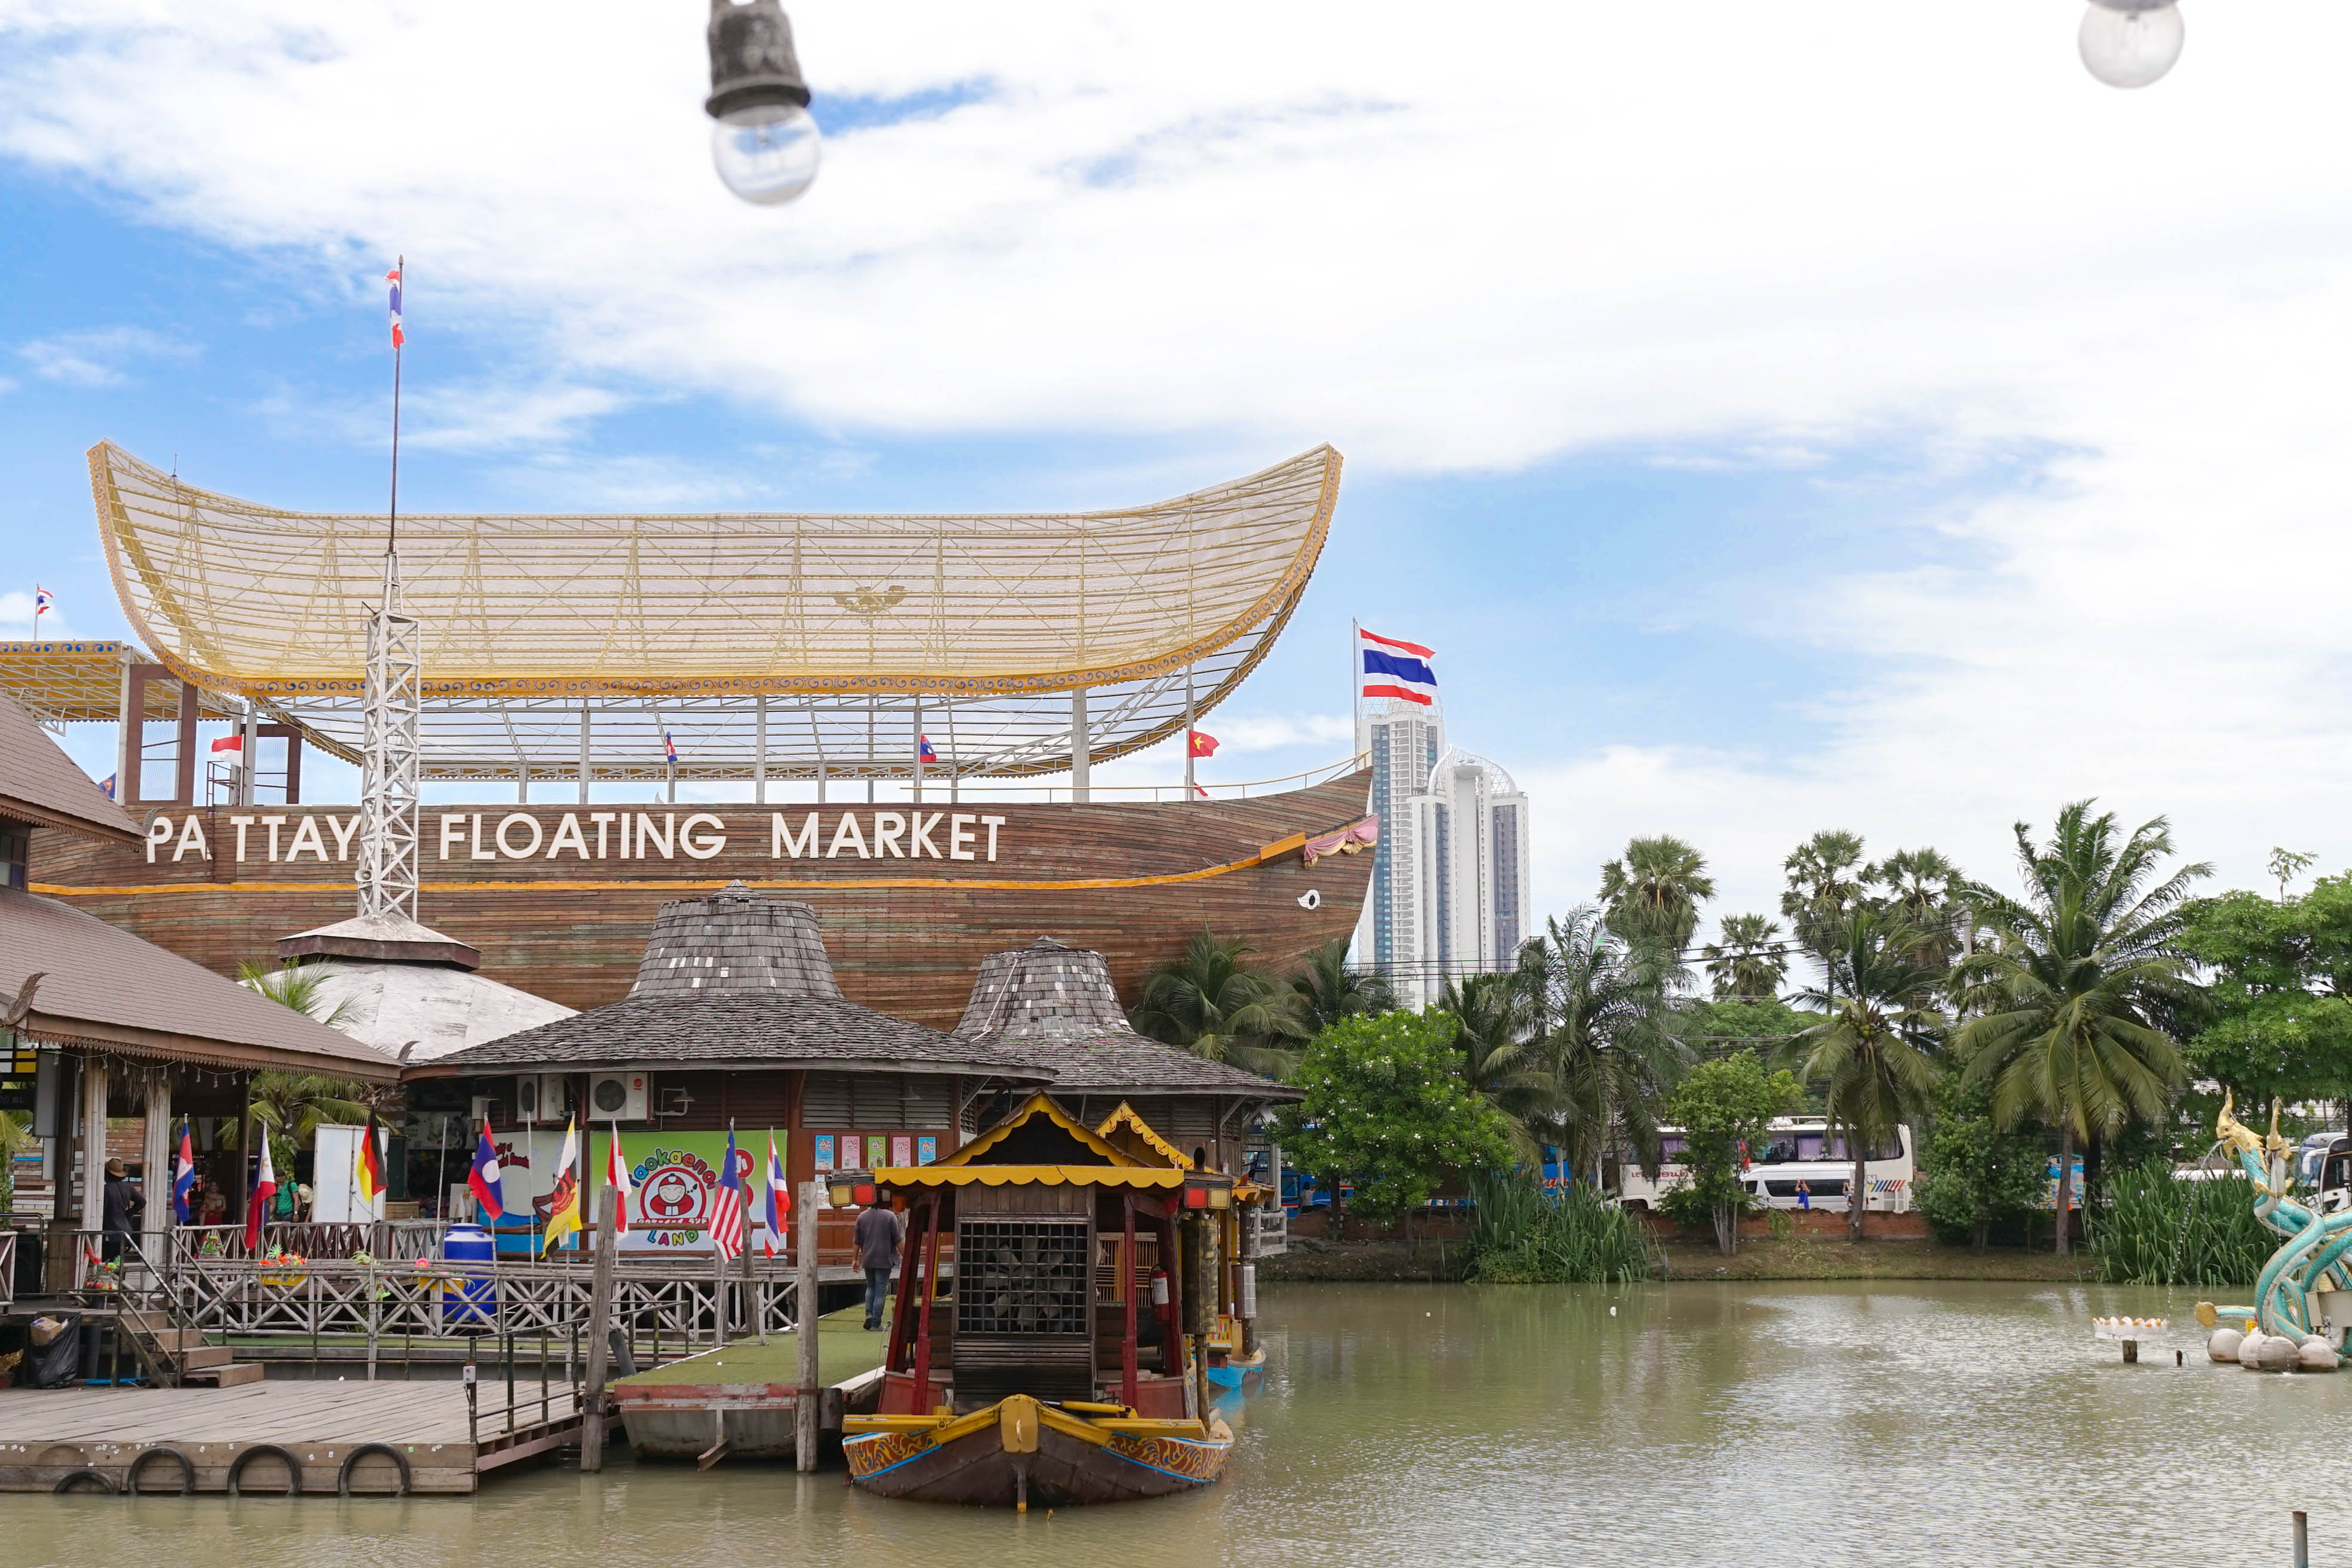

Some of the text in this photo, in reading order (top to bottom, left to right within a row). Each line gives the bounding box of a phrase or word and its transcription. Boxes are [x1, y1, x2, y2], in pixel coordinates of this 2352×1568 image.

[439, 811, 727, 860] FLOATING
[771, 811, 1006, 862] MARKET
[647, 1229, 699, 1247] LAND
